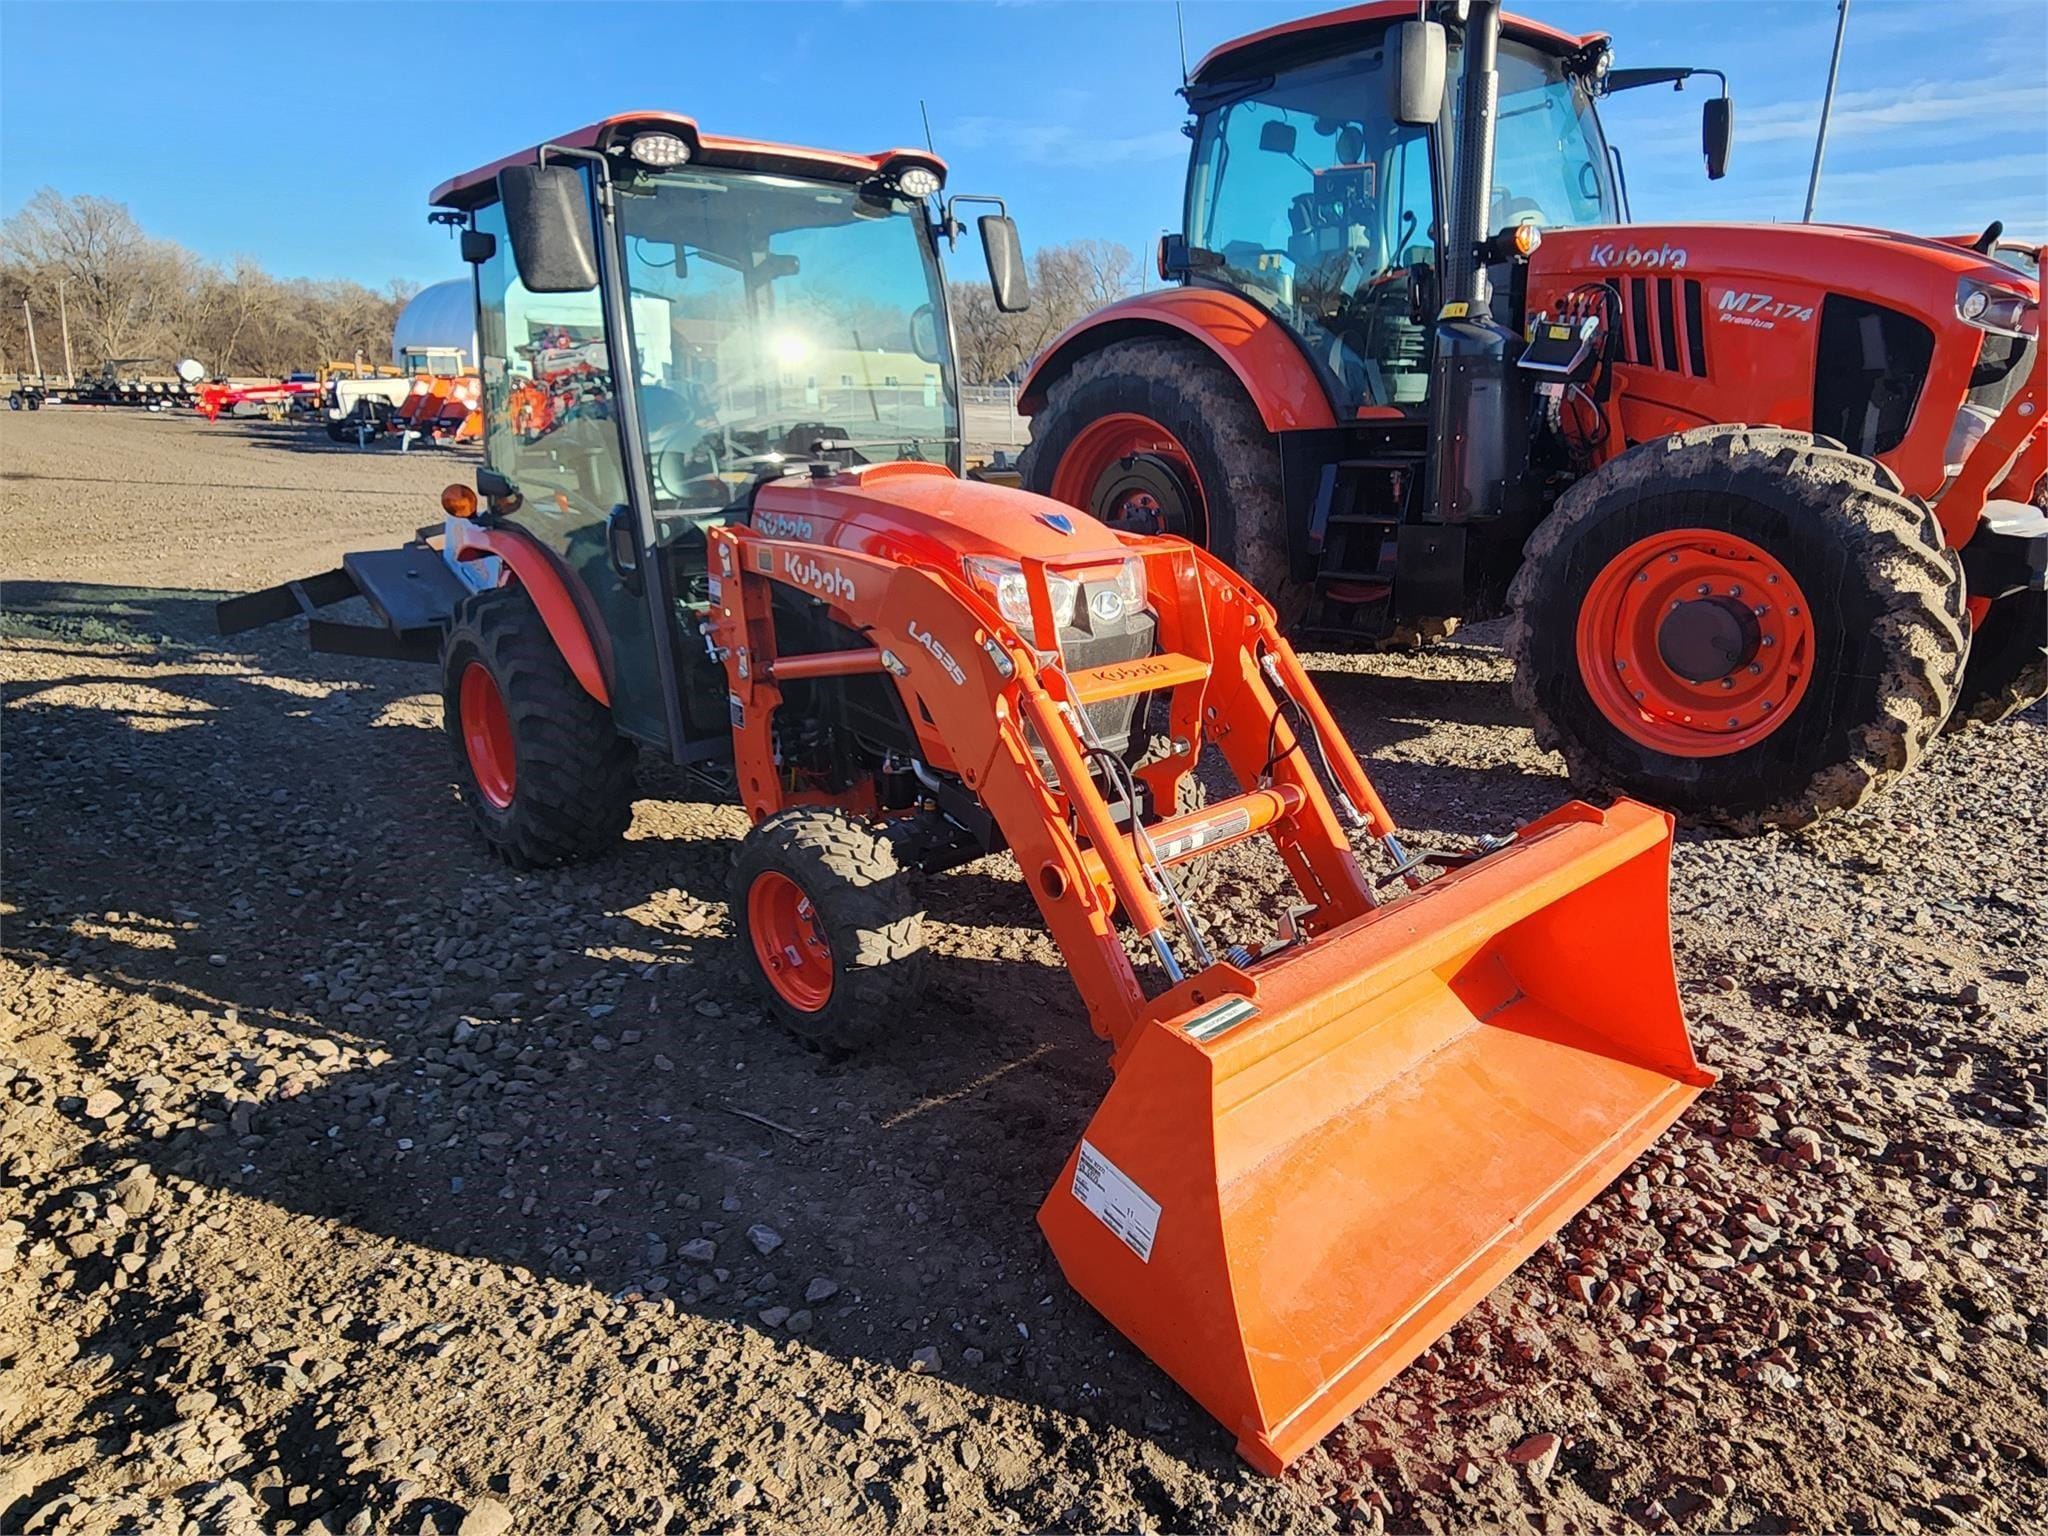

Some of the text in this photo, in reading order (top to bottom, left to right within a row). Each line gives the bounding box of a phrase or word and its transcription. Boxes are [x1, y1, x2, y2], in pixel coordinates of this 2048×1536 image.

[1590, 242, 1688, 270] Kubota
[1718, 289, 1814, 322] M7-174
[1719, 313, 1775, 330] Premium
[757, 512, 813, 540] Kubota
[784, 551, 856, 601] Kubota
[907, 619, 967, 686] LA535
[1092, 662, 1170, 681] Kubota
